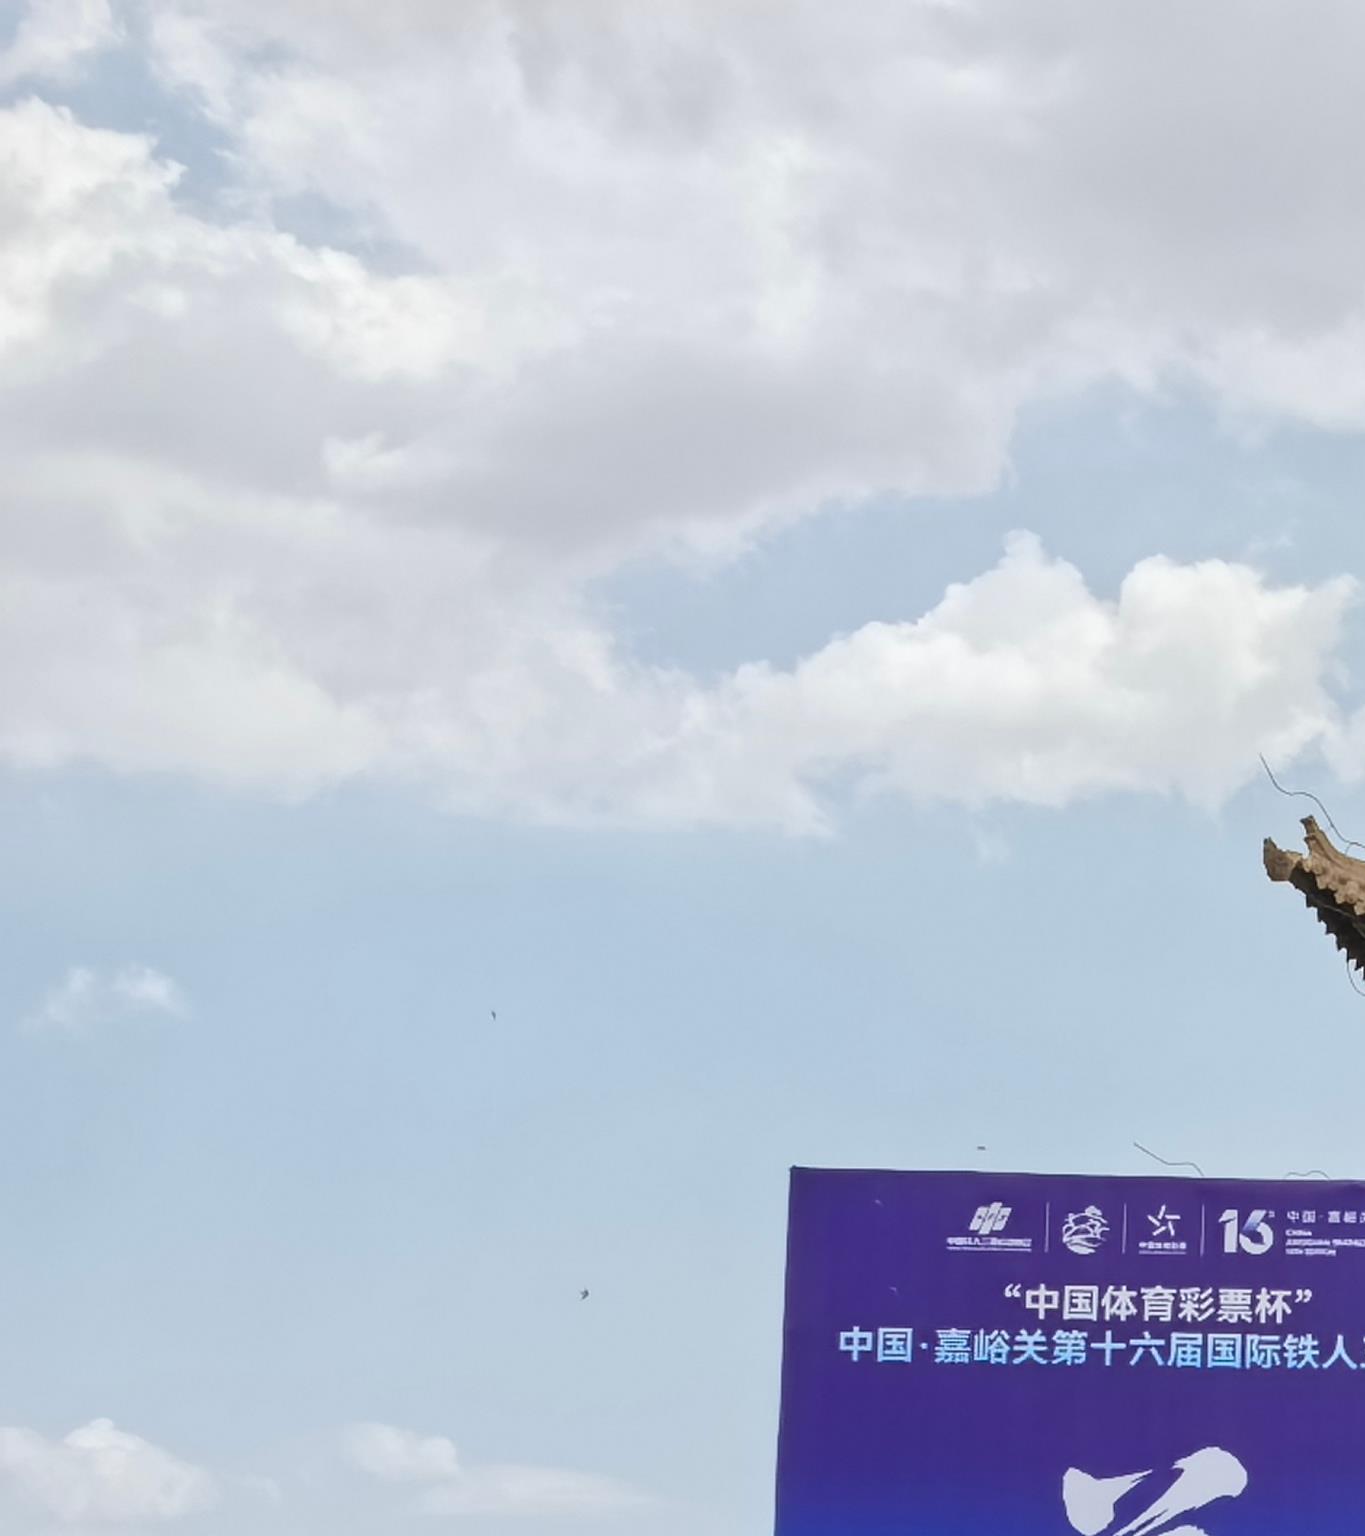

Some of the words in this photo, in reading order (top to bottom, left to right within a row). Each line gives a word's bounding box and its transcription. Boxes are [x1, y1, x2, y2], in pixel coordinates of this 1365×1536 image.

[1003, 1284, 1313, 1325] “中国体育彩票杯”
